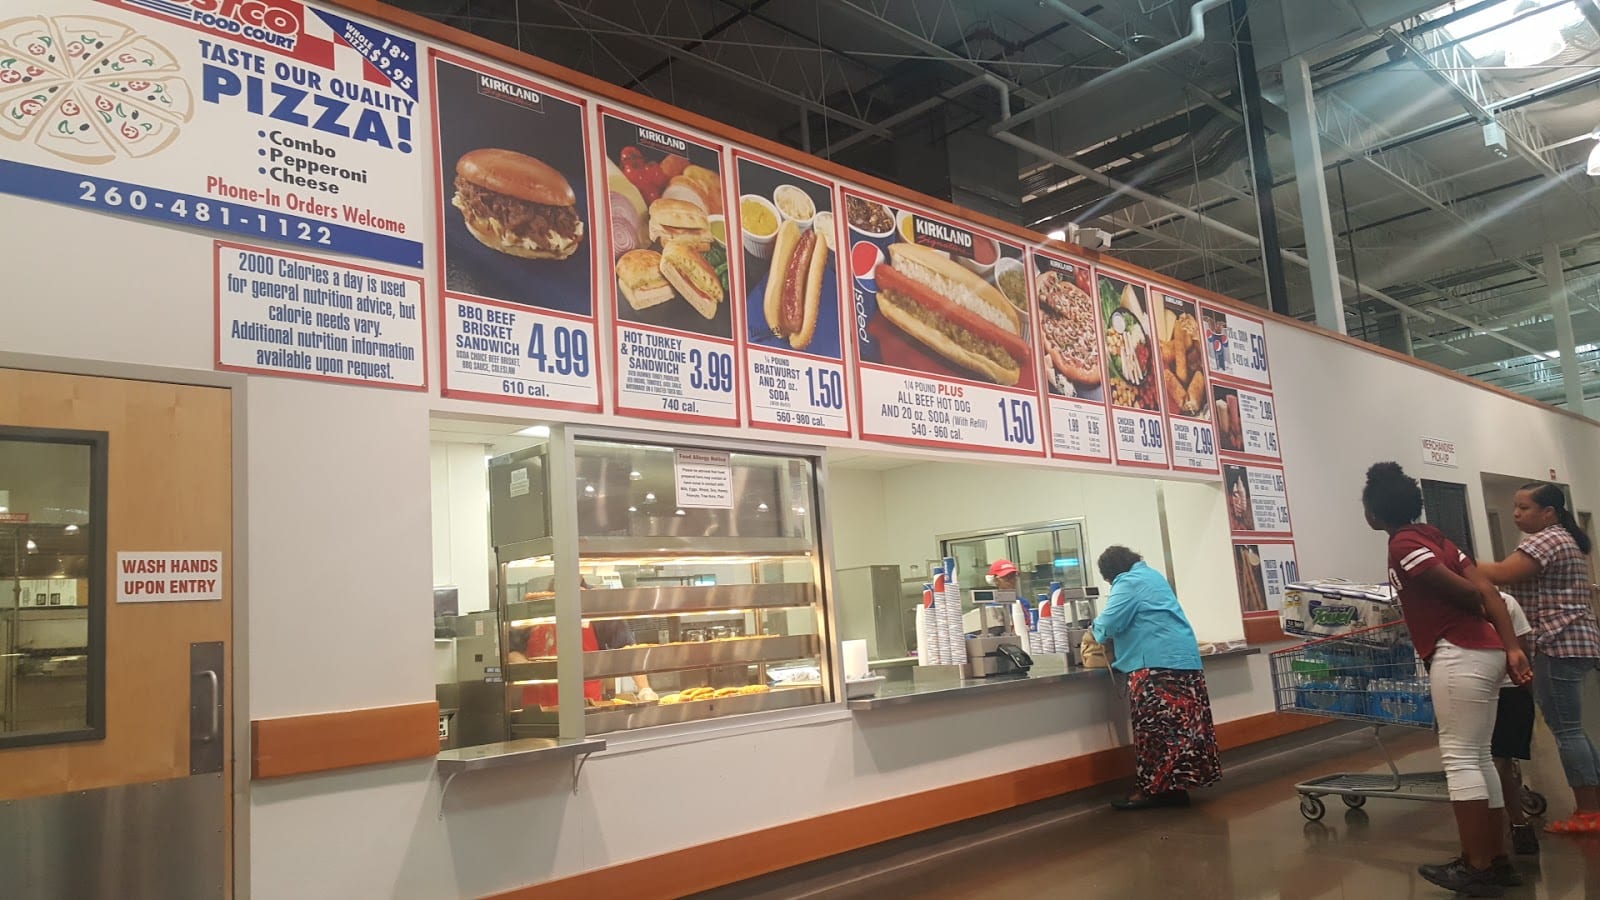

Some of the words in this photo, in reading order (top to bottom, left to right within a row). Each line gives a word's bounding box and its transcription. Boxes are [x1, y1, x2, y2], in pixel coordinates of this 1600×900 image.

[193, 11, 240, 33] FOOD
[243, 25, 295, 49] COURT
[346, 22, 374, 50] WHOLE
[344, 32, 369, 56] PIZZA
[370, 49, 413, 89] $9.95
[199, 39, 265, 75] TASTE
[275, 62, 322, 91] OUR
[330, 78, 414, 116] QUALITY
[480, 76, 540, 103] KIRKLAND
[202, 63, 413, 154] PIZZA!
[269, 130, 337, 159] Combo
[639, 128, 686, 150] KIRKLAND
[270, 147, 368, 184] Pepperoni
[270, 167, 340, 195] Cheese
[79, 181, 332, 245] 260-481-1122
[207, 175, 281, 208] Phone-In
[286, 191, 338, 219] Orders
[343, 204, 406, 235] Welcome
[916, 219, 972, 248] KIRKLAND
[239, 252, 274, 275] 2000
[278, 259, 329, 285] Calories
[333, 271, 339, 286] a
[344, 271, 364, 293] day
[367, 275, 377, 293] is
[381, 281, 406, 298] used
[227, 273, 247, 293] for
[252, 278, 299, 301] general
[303, 288, 352, 310] nutrition
[356, 295, 396, 319] advice,
[399, 301, 416, 320] but
[268, 305, 312, 326] calorie
[316, 311, 350, 331] needs
[353, 318, 382, 338] vary.
[458, 304, 483, 321] BBQ
[487, 309, 516, 326] BEEF
[853, 287, 870, 343] pepsi
[231, 319, 293, 346] Additional
[297, 331, 347, 353] nutrition
[351, 336, 415, 361] information
[463, 320, 512, 340] BRISKET
[624, 330, 643, 344] HOT
[646, 334, 682, 351] TURKEY
[256, 348, 312, 370] available
[316, 356, 343, 375] upon
[347, 359, 394, 380] request.
[456, 334, 520, 356] SANDWICH
[527, 322, 590, 377] 4.99
[771, 357, 789, 367] POUND
[1250, 333, 1266, 372] .59
[620, 343, 628, 355] &
[631, 345, 686, 364] PROVOLONE
[689, 348, 733, 393] 3.99
[629, 357, 679, 375] SANDWICH
[754, 363, 800, 380] BRATWURST
[502, 380, 524, 395] 610
[528, 384, 550, 397] cal.
[758, 376, 775, 388] AND
[777, 379, 786, 389] 20
[788, 383, 798, 391] oz.
[769, 389, 790, 401] SODA
[805, 366, 843, 410] 1.50
[904, 380, 914, 391] 1/4
[914, 382, 937, 394] POUND
[938, 384, 964, 398] PLUS
[662, 398, 679, 411] 740
[682, 401, 699, 412] cal.
[898, 391, 914, 405] ALL
[915, 394, 935, 408] BEEF
[936, 397, 953, 411] HOT
[954, 400, 971, 413] DOG
[776, 411, 791, 423] 560
[796, 413, 810, 425] 980
[812, 416, 825, 426] cal.
[881, 404, 900, 418] AND
[901, 407, 912, 420] 20
[914, 413, 926, 421] oz.
[928, 411, 950, 425] SODA
[952, 416, 969, 427] (With
[969, 417, 988, 430] Refill)
[911, 422, 927, 435] 540
[934, 426, 948, 439] 960
[950, 428, 963, 440] cal.
[998, 397, 1035, 445] 1.50
[1140, 417, 1162, 448] 3.99
[1193, 426, 1213, 455] 2.99
[122, 559, 166, 574] WASH
[170, 559, 218, 573] HANDS
[124, 580, 165, 595] UPON
[169, 579, 216, 594] ENTRY
